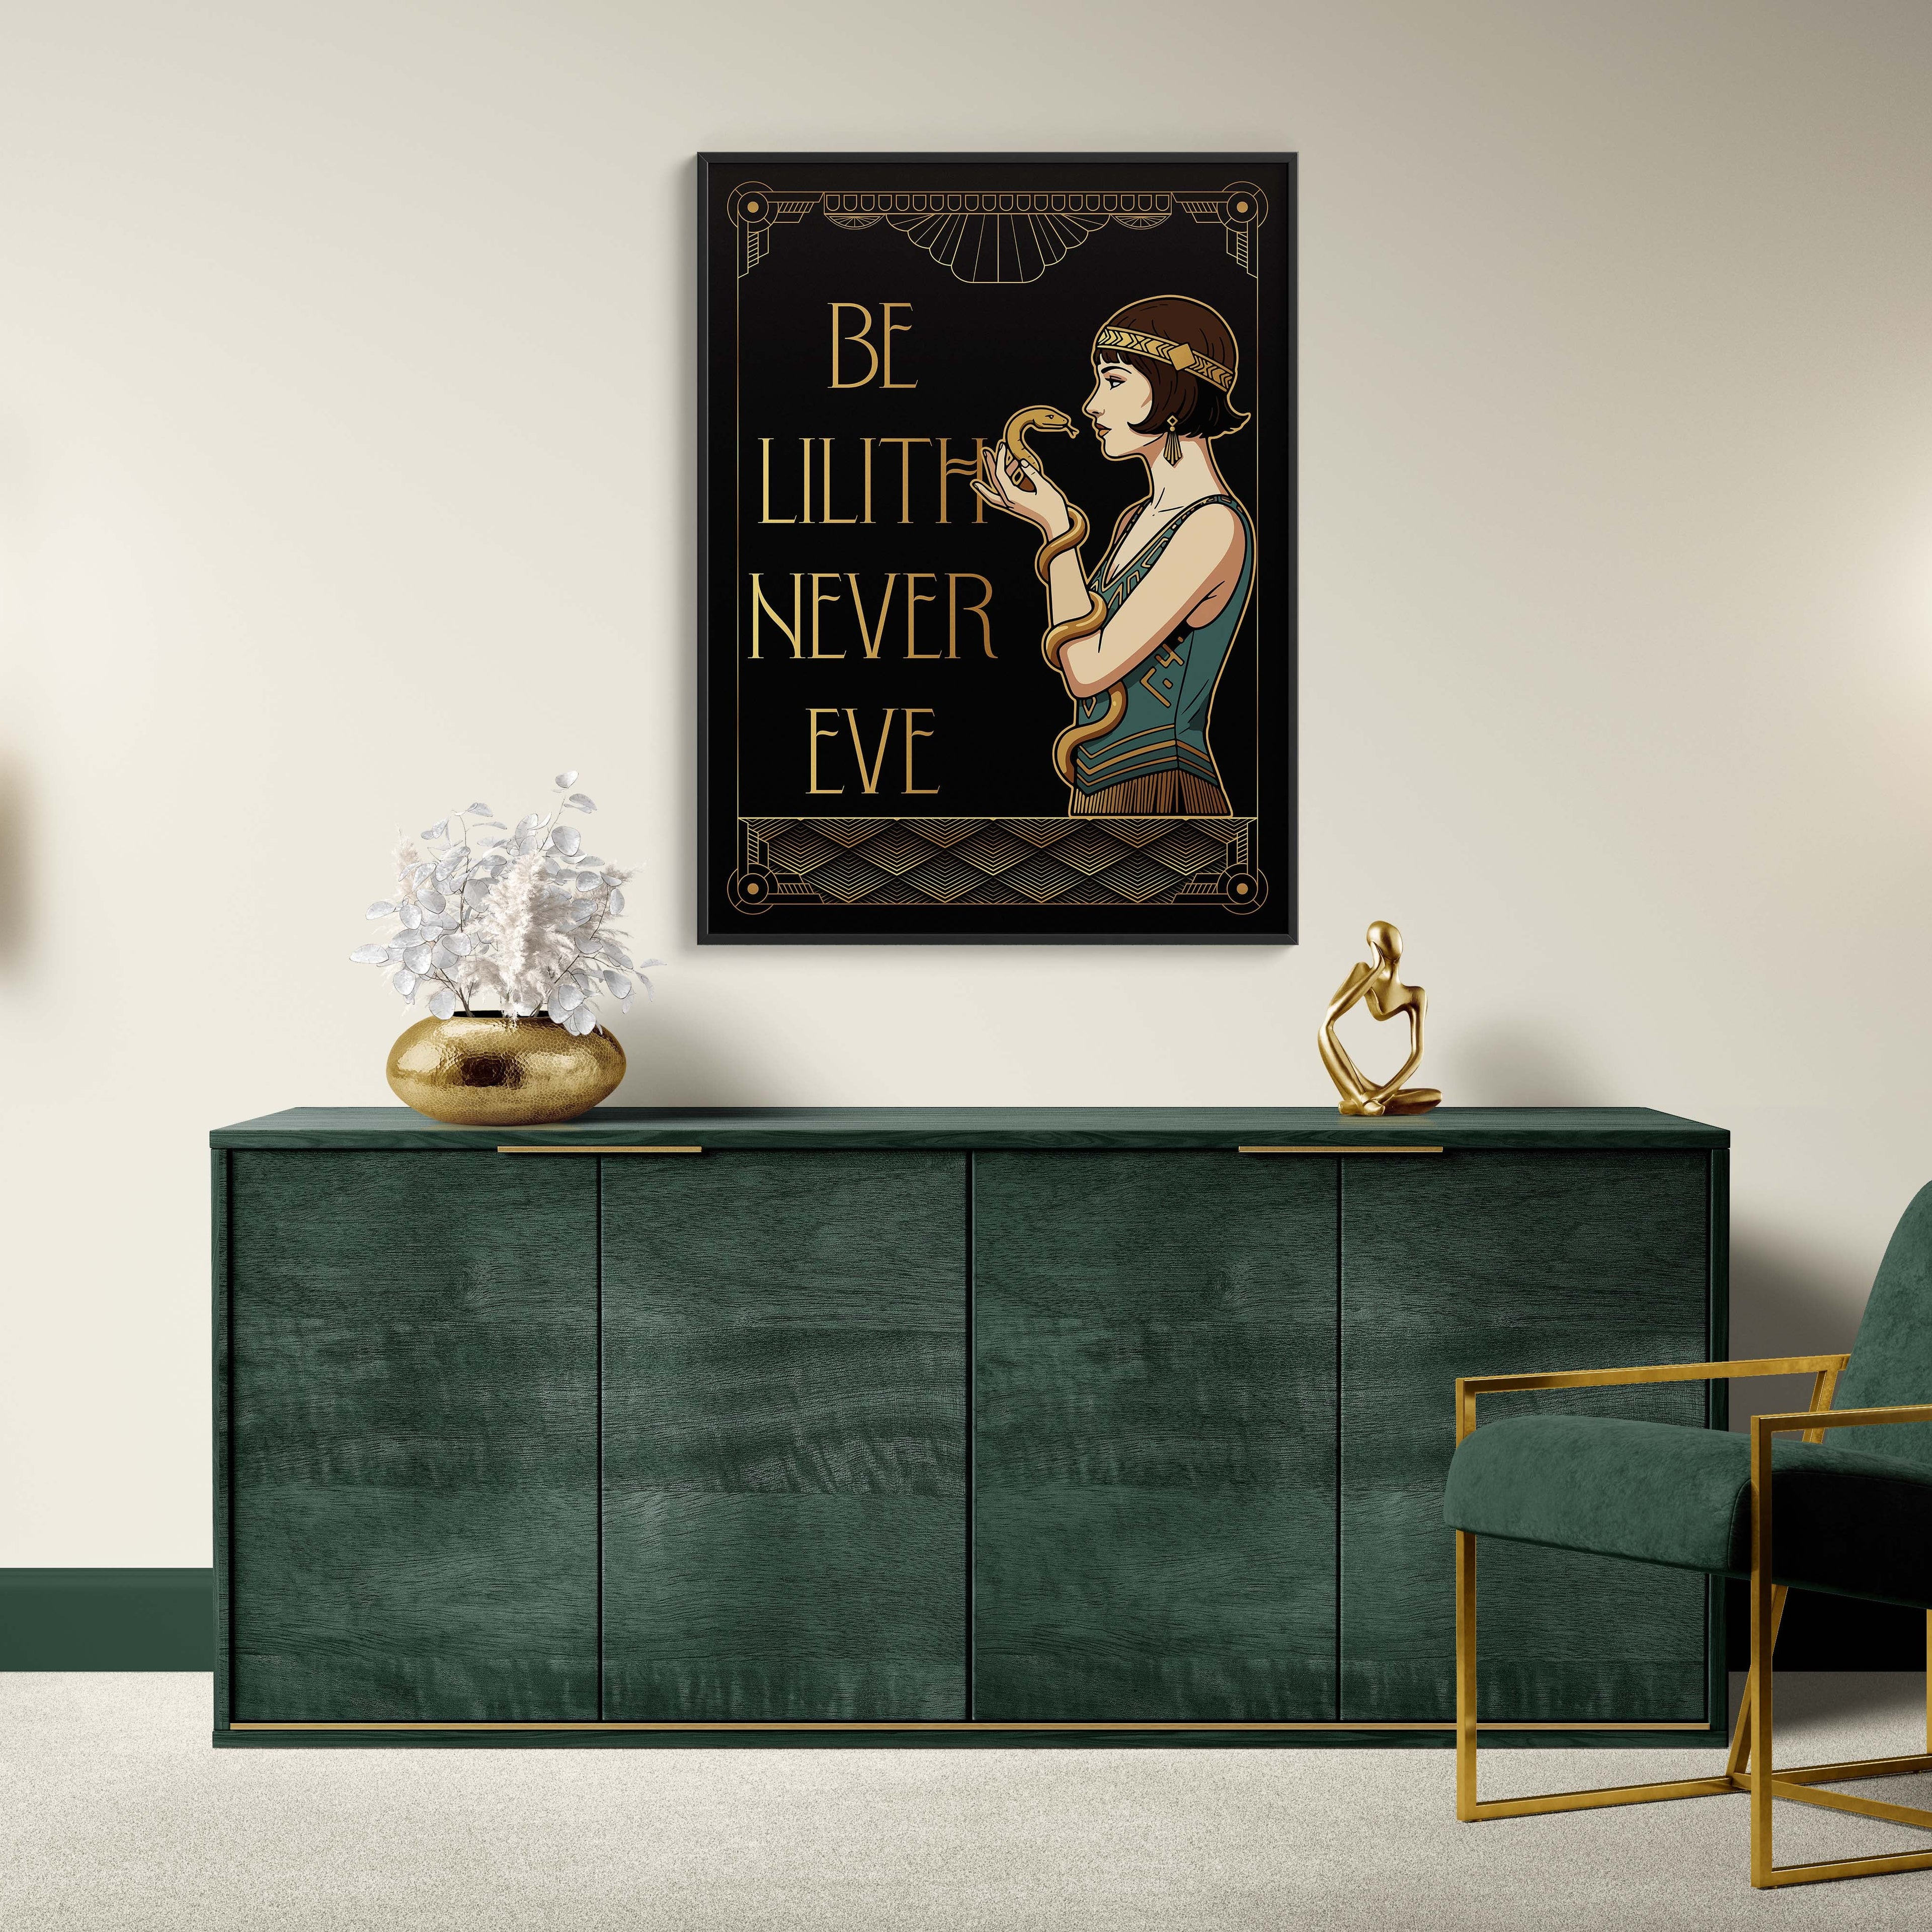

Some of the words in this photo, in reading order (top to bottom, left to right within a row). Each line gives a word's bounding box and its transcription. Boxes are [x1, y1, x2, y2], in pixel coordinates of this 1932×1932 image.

[828, 303, 918, 388] BE
[758, 438, 988, 523] LILITH
[748, 574, 998, 658] NEVER
[806, 708, 940, 793] EVE
